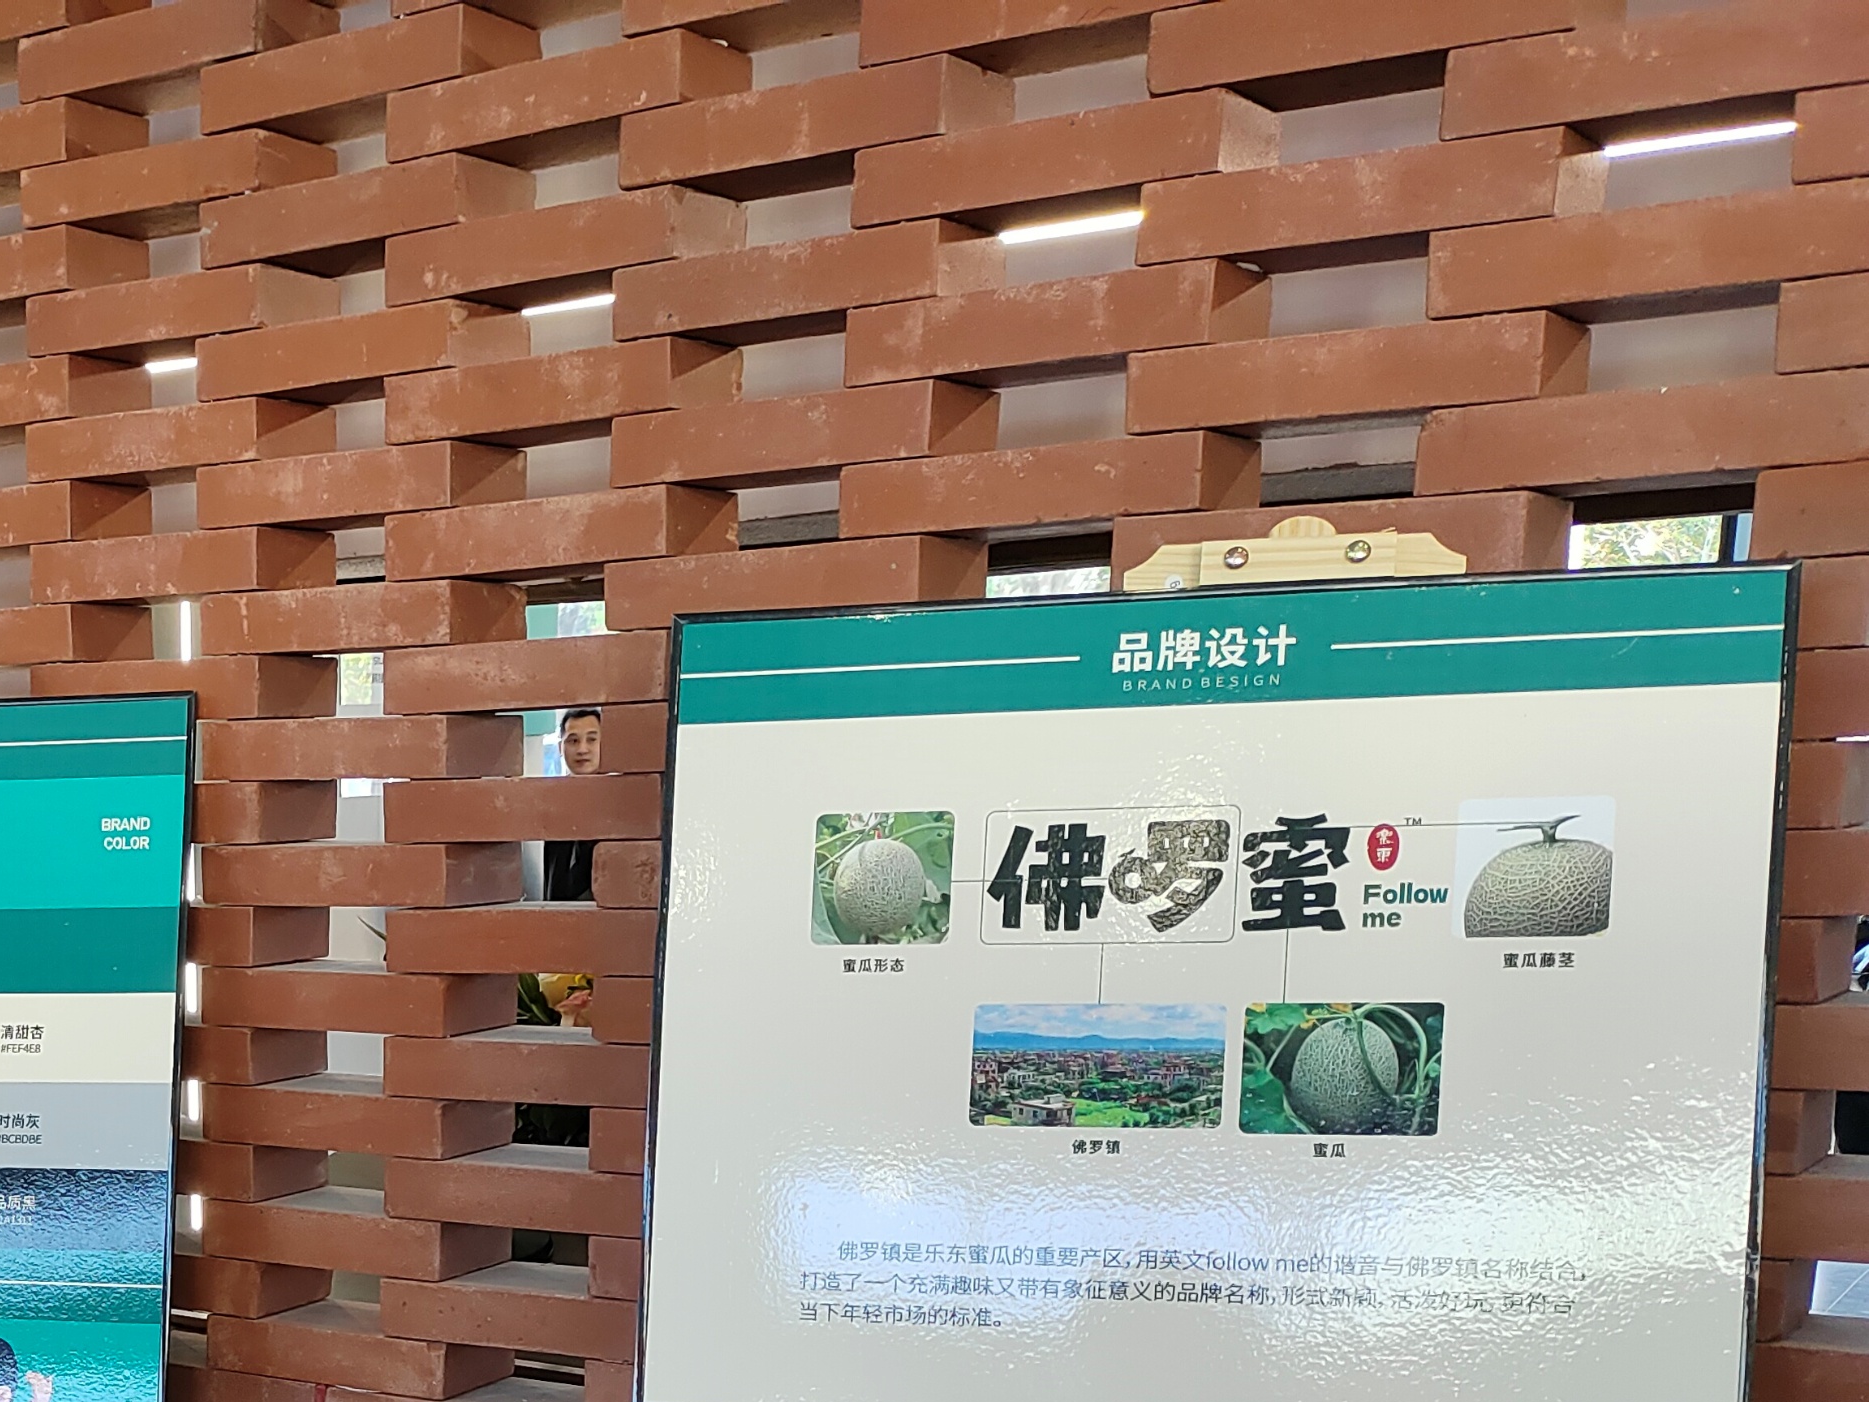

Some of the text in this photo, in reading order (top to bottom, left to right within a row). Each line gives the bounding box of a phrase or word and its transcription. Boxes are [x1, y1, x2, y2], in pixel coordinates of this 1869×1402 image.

[1111, 623, 1297, 674] 品牌设计
[1123, 677, 1193, 692] BRAND
[101, 815, 151, 832] BRAND
[103, 835, 150, 851] COLOR
[1363, 882, 1449, 905] Follow
[1362, 911, 1402, 928] me
[842, 957, 905, 974] 蜜瓜形态
[1502, 951, 1576, 969] 蜜瓜藤茎
[0, 1024, 45, 1040] 清甜杏
[1071, 1139, 1121, 1155] 佛罗镇
[1313, 1142, 1346, 1158] 蜜瓜
